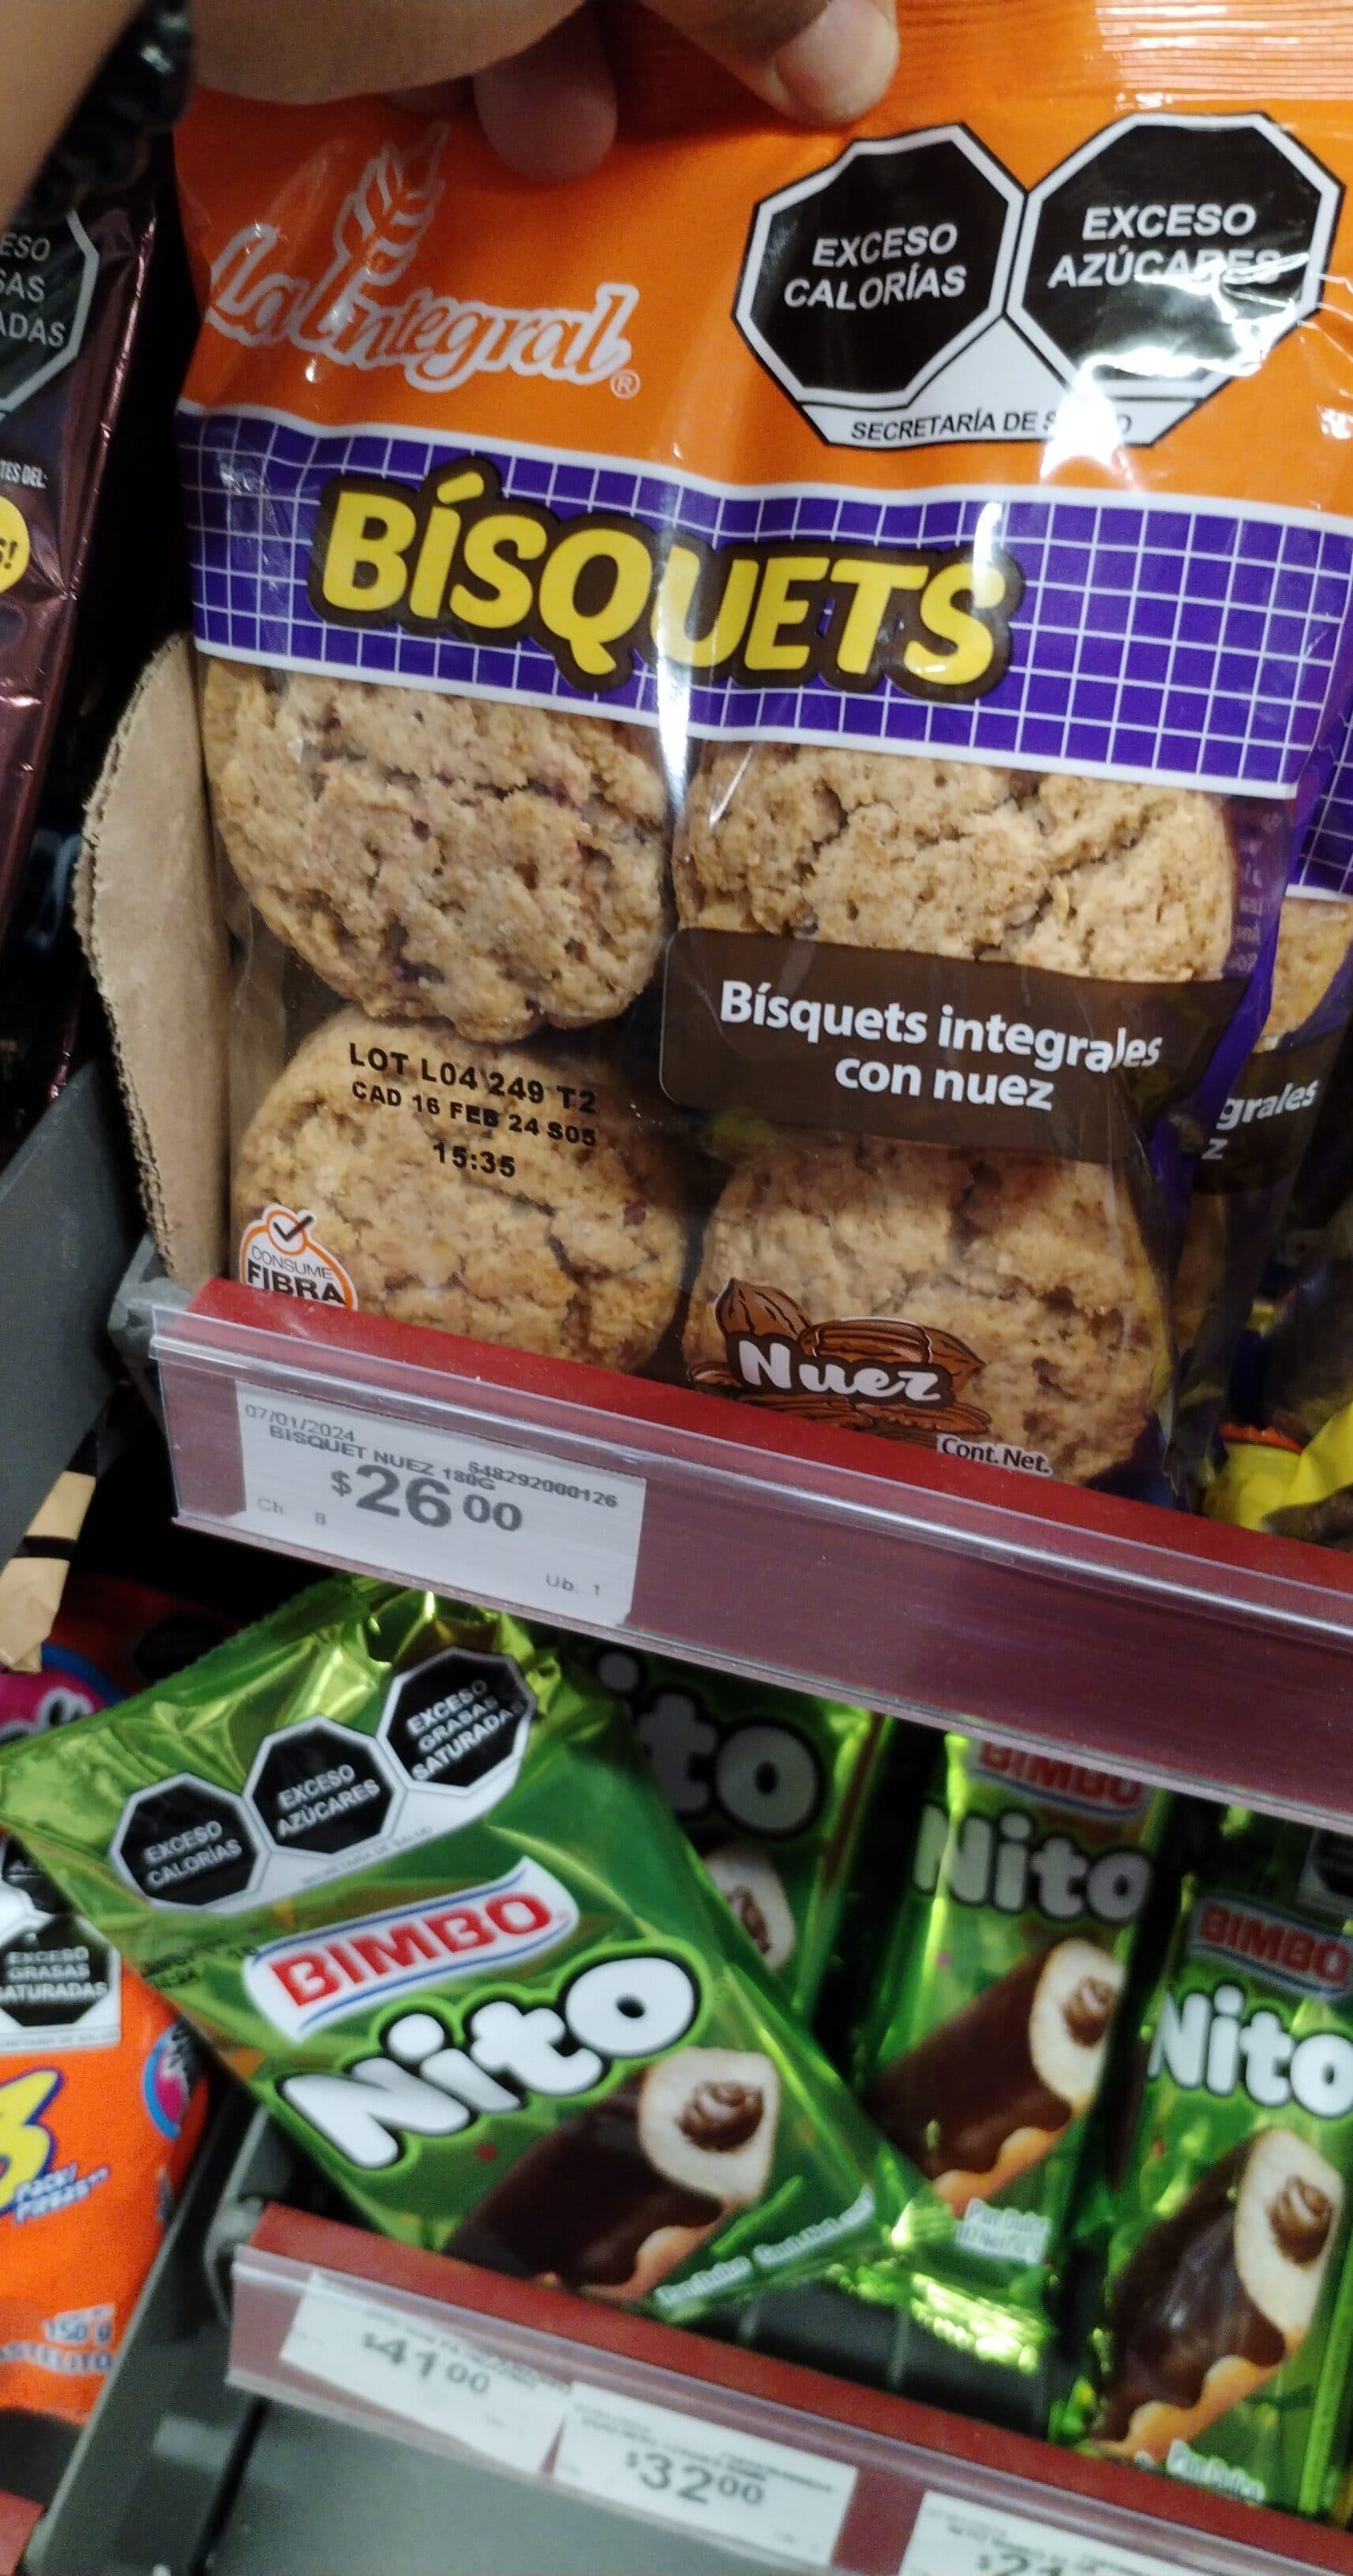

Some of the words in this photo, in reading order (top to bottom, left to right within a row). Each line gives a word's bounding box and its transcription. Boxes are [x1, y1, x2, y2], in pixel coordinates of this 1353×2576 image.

[811, 223, 958, 269] EXCESO
[1082, 203, 1257, 241] EXCESO
[784, 266, 967, 310] CALORÍAS
[851, 406, 996, 442] SECRETARÍA
[1003, 411, 1037, 432] DE
[322, 472, 1006, 685] BÍSQUETS
[720, 980, 928, 1048] Bísquets
[939, 1005, 1163, 1072] integrales
[350, 1043, 408, 1075] LOT
[422, 1058, 478, 1090] L04
[489, 1073, 544, 1104] 249
[557, 1085, 596, 1114] T2
[836, 1058, 922, 1096] con
[934, 1065, 1054, 1110] nuez
[352, 1081, 401, 1106] CAD
[412, 1095, 440, 1115] 16
[450, 1102, 499, 1127] FEB
[509, 1114, 540, 1136] 24
[433, 1142, 515, 1178] 15:35
[247, 1260, 346, 1305] FIBRA
[252, 1246, 335, 1281] CONSUME
[738, 1340, 941, 1402] Nuez
[245, 1404, 354, 1442] 07/01/2024
[270, 1425, 366, 1459] BISQUET
[373, 1449, 434, 1477] NUEZ
[942, 1436, 997, 1465] Cont.
[1003, 1447, 1051, 1476] Net.
[407, 1679, 487, 1735] EXCESO
[278, 1764, 355, 1810] EXCESO
[143, 1820, 223, 1865] EXCESO
[913, 1804, 1151, 1922] Nito
[7, 1946, 89, 1967] EXCESO
[268, 1892, 552, 2007] BIMBO
[1200, 1903, 1351, 1983] BIMBO
[283, 1957, 695, 2168] Nito
[1148, 1984, 1353, 2117] Nito
